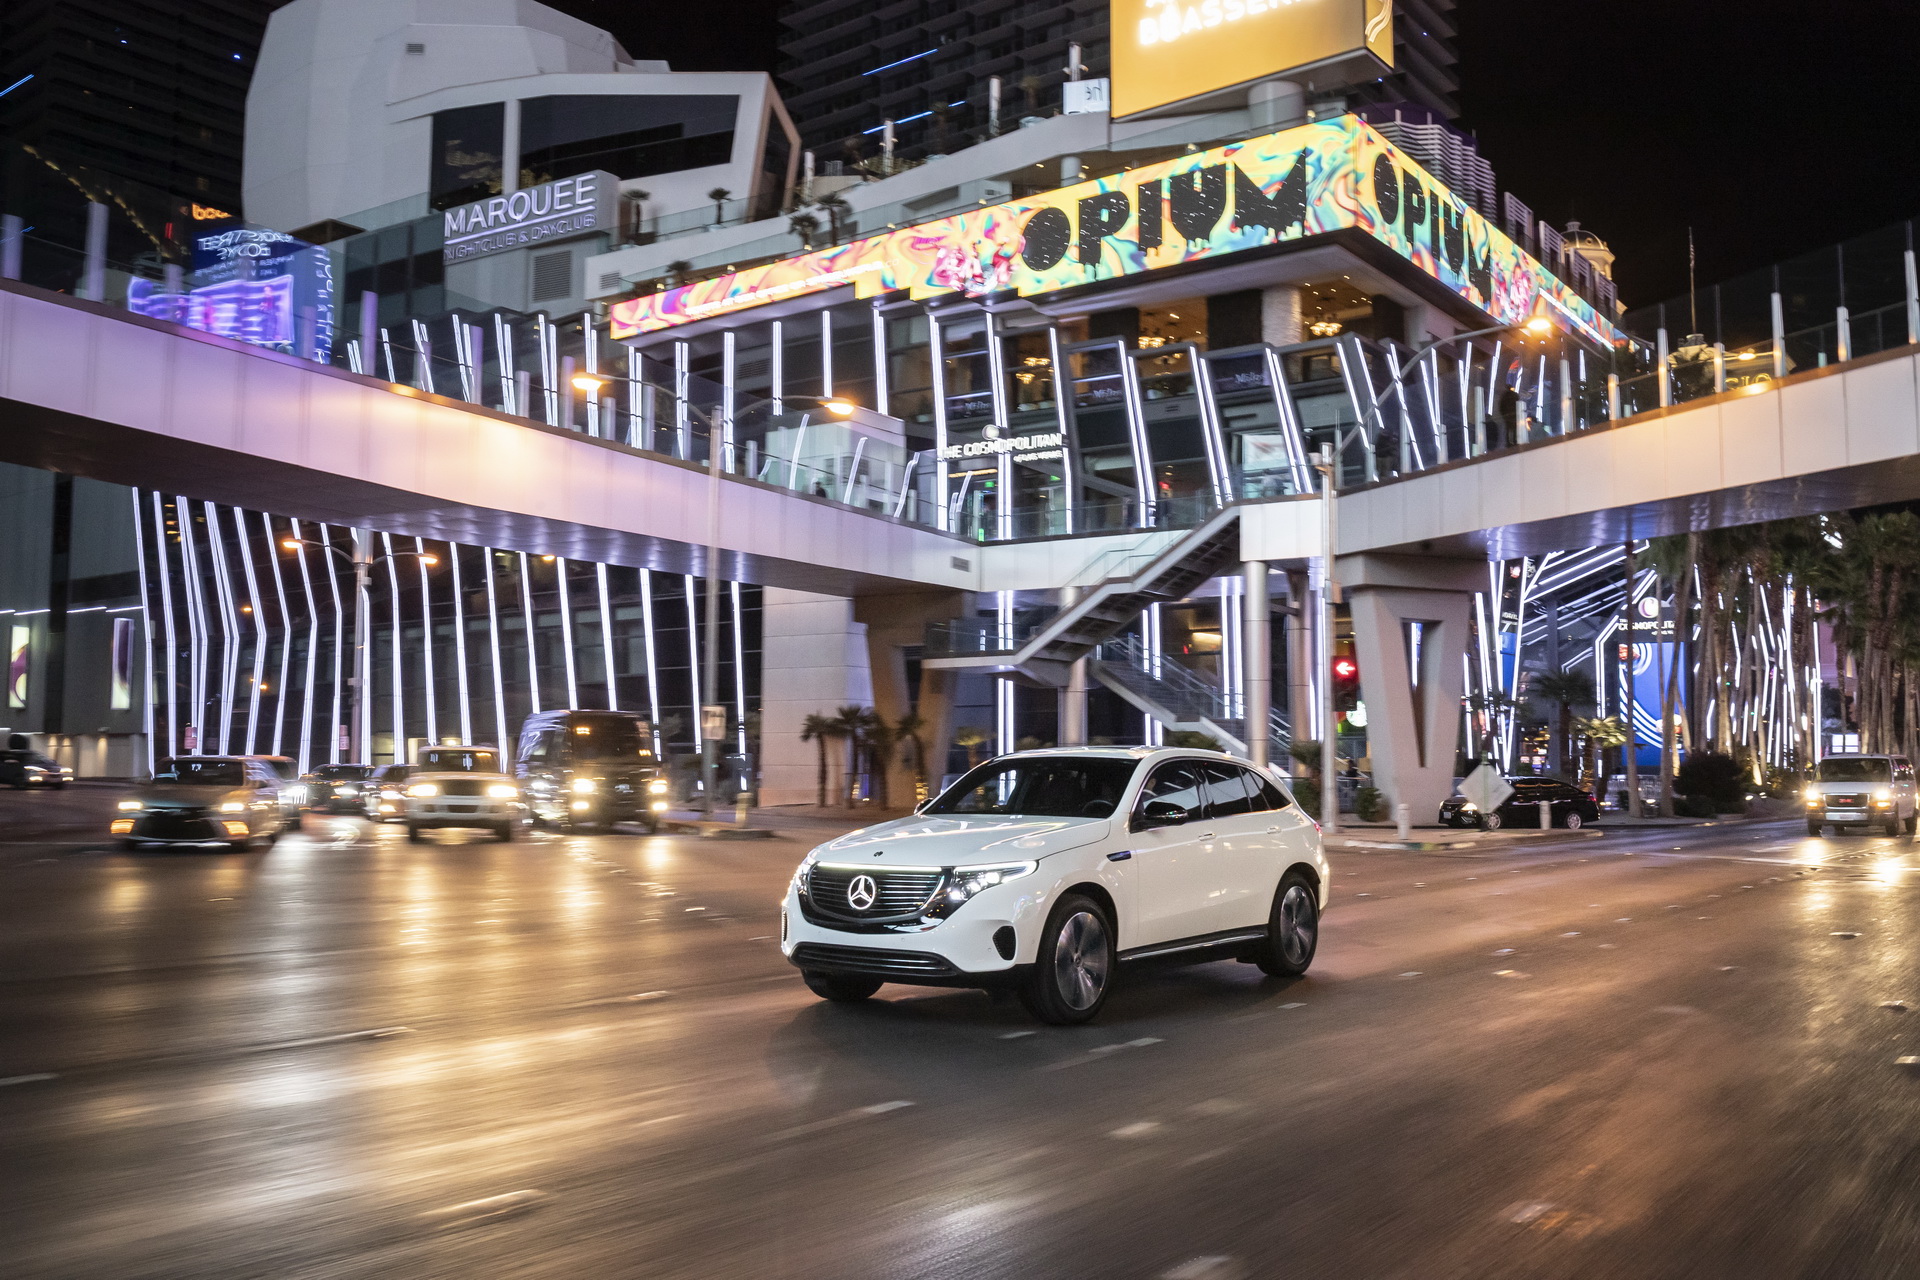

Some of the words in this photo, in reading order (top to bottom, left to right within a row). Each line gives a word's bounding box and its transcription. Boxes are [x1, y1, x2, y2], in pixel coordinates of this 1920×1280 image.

[444, 173, 597, 238] MARQUEE
[444, 232, 517, 261] NIGHTCLUB
[518, 230, 529, 243] &
[531, 213, 597, 240] DAYCLUB
[1022, 143, 1306, 280] OPIUM
[1373, 152, 1492, 305] OPIUM
[963, 432, 1063, 457] COSMOPOLITAN
